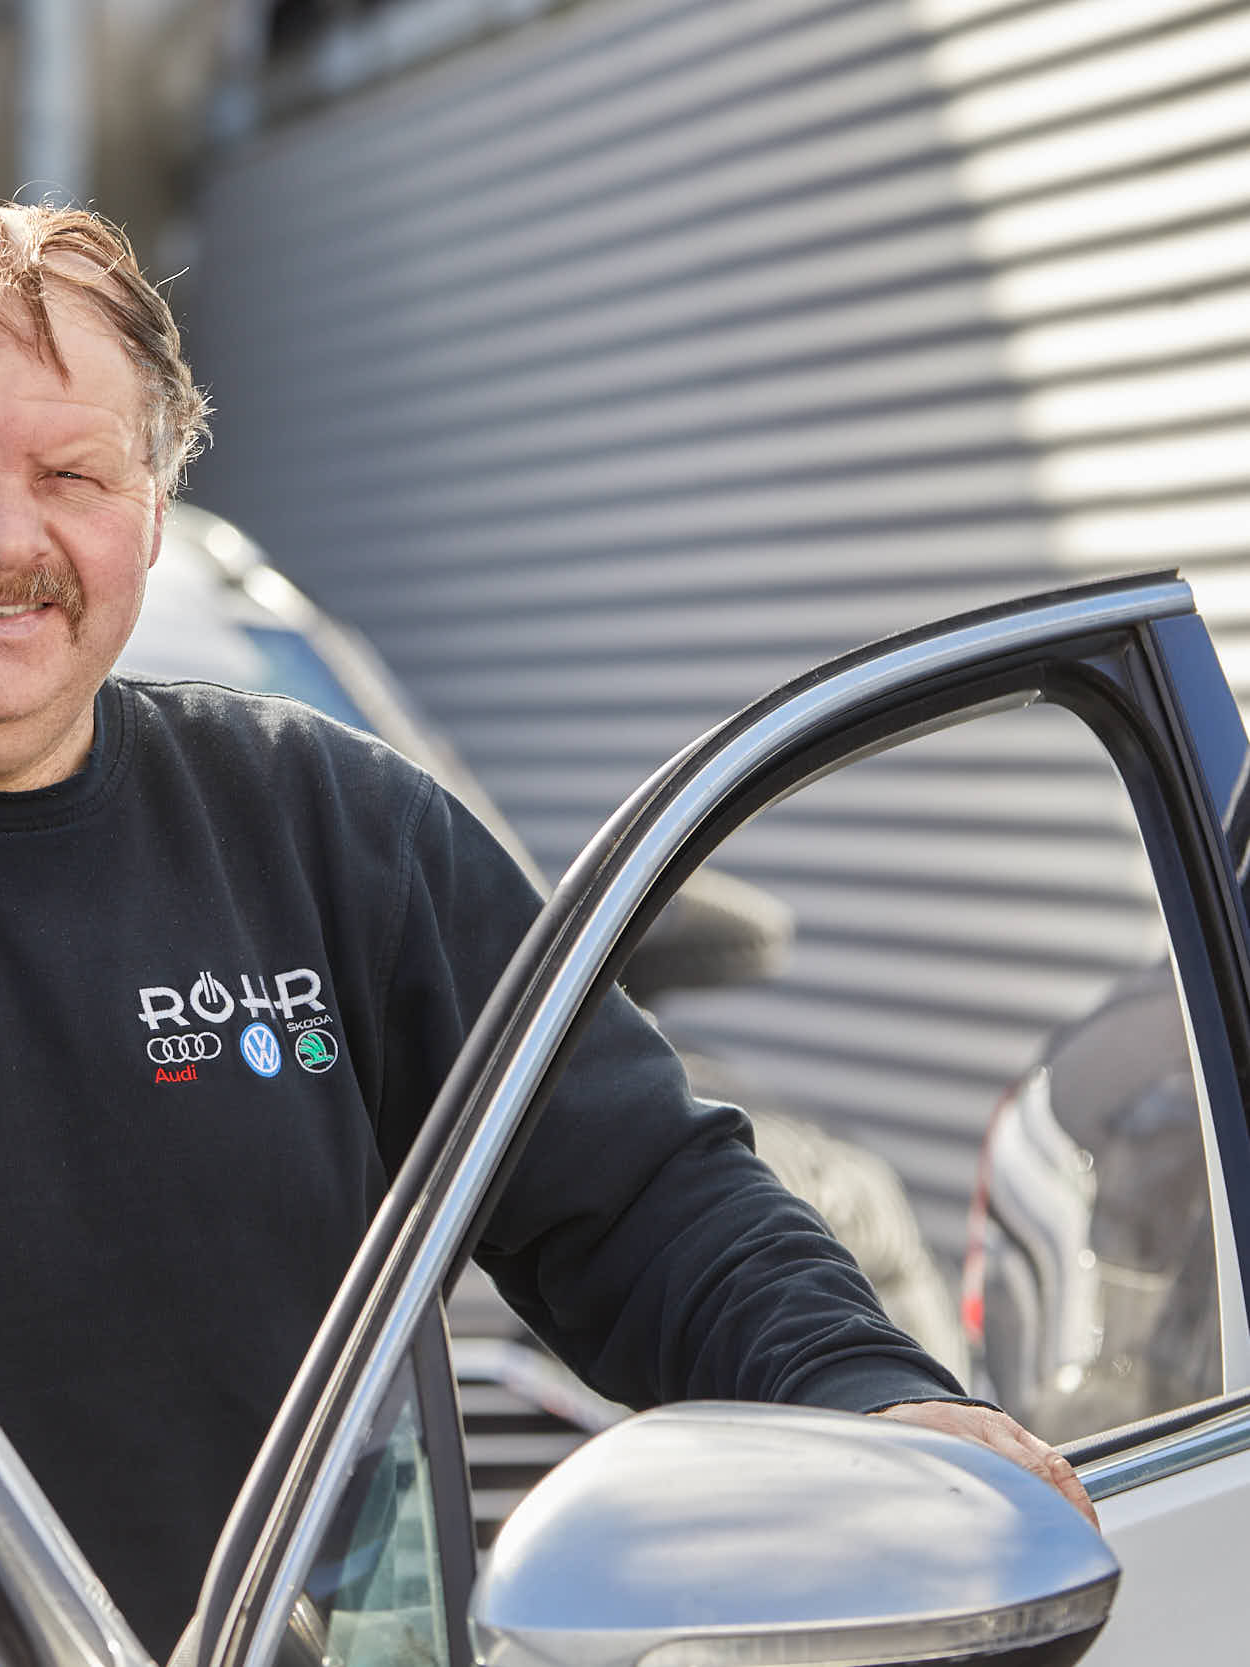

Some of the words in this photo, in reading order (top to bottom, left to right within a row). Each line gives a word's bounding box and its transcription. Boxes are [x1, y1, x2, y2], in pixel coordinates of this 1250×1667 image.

[138, 968, 326, 1030] RÖHR
[154, 1064, 198, 1084] Audi
[240, 1024, 281, 1076] VW
